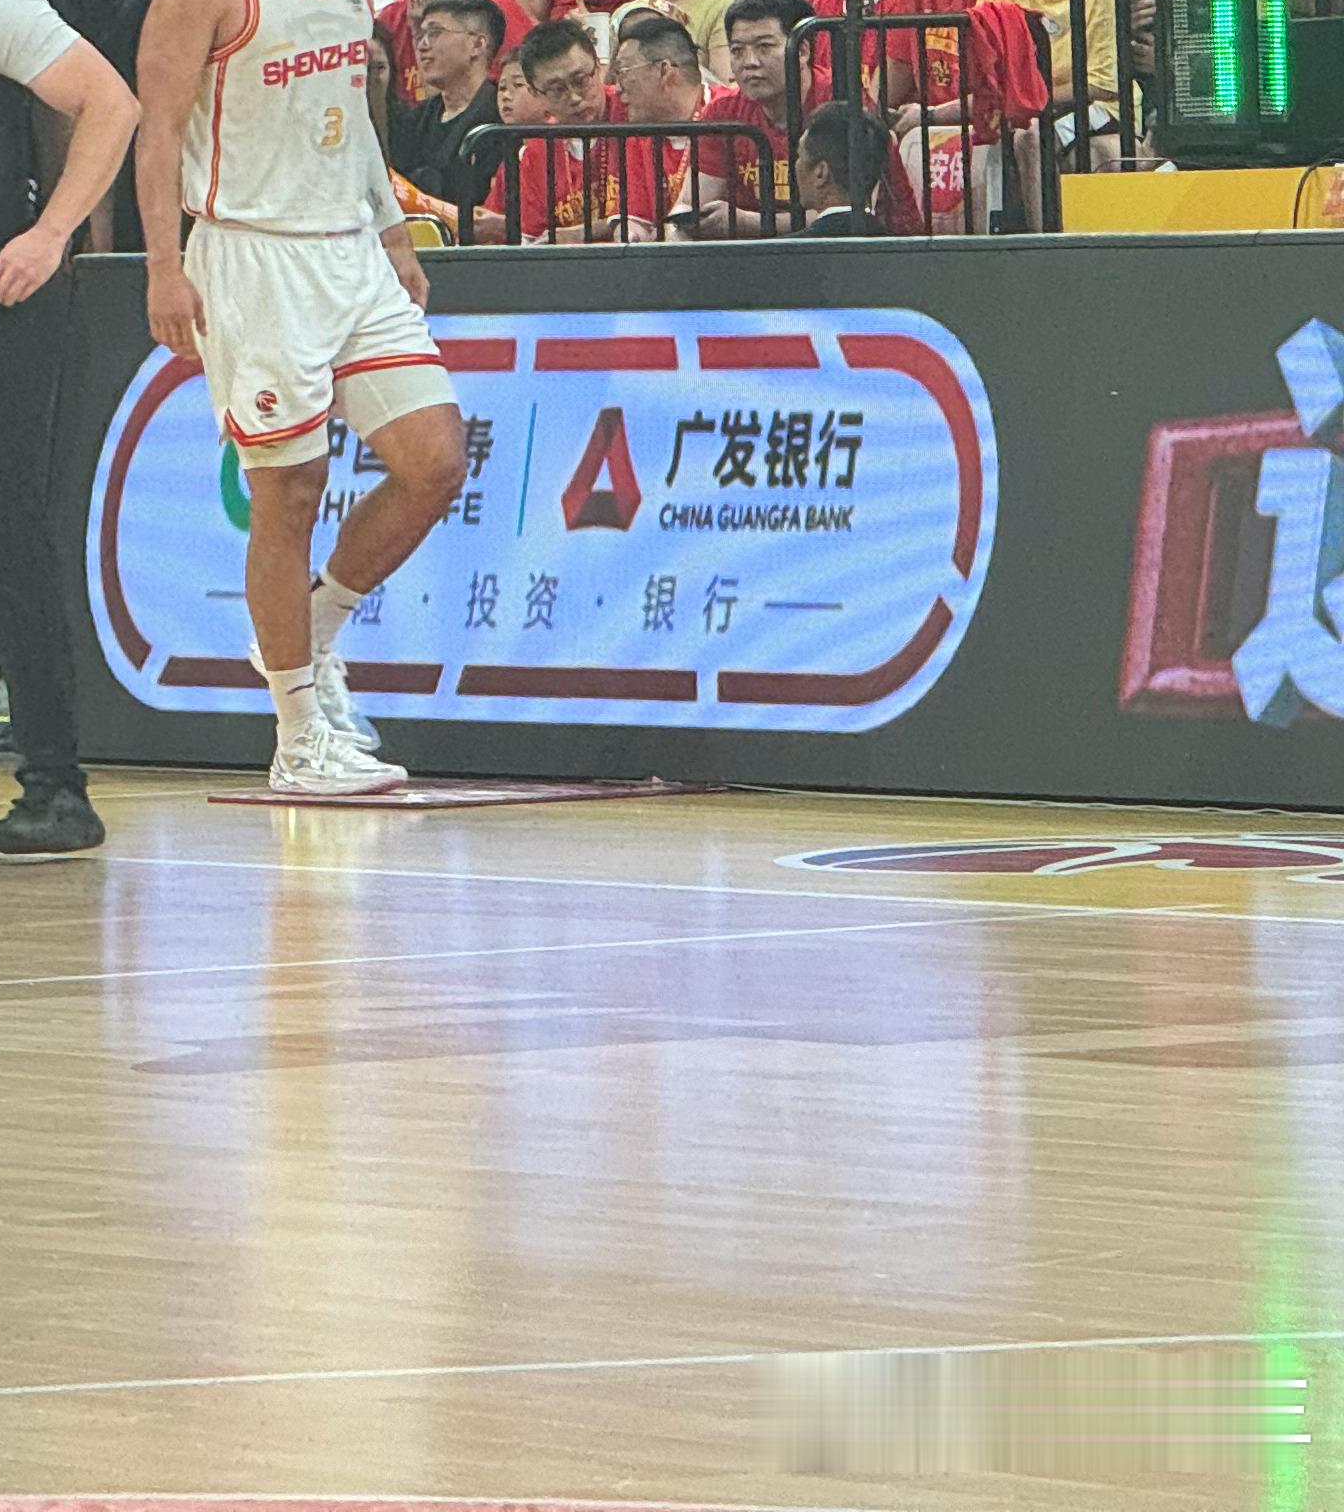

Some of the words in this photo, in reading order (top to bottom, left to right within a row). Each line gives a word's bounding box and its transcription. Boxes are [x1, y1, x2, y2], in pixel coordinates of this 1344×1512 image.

[262, 39, 369, 88] SHENZHE
[320, 106, 345, 147] 3
[665, 409, 864, 489] 广发银行
[659, 503, 713, 532] CHINA
[717, 504, 802, 532] GUANGFA
[804, 504, 855, 533] BANK
